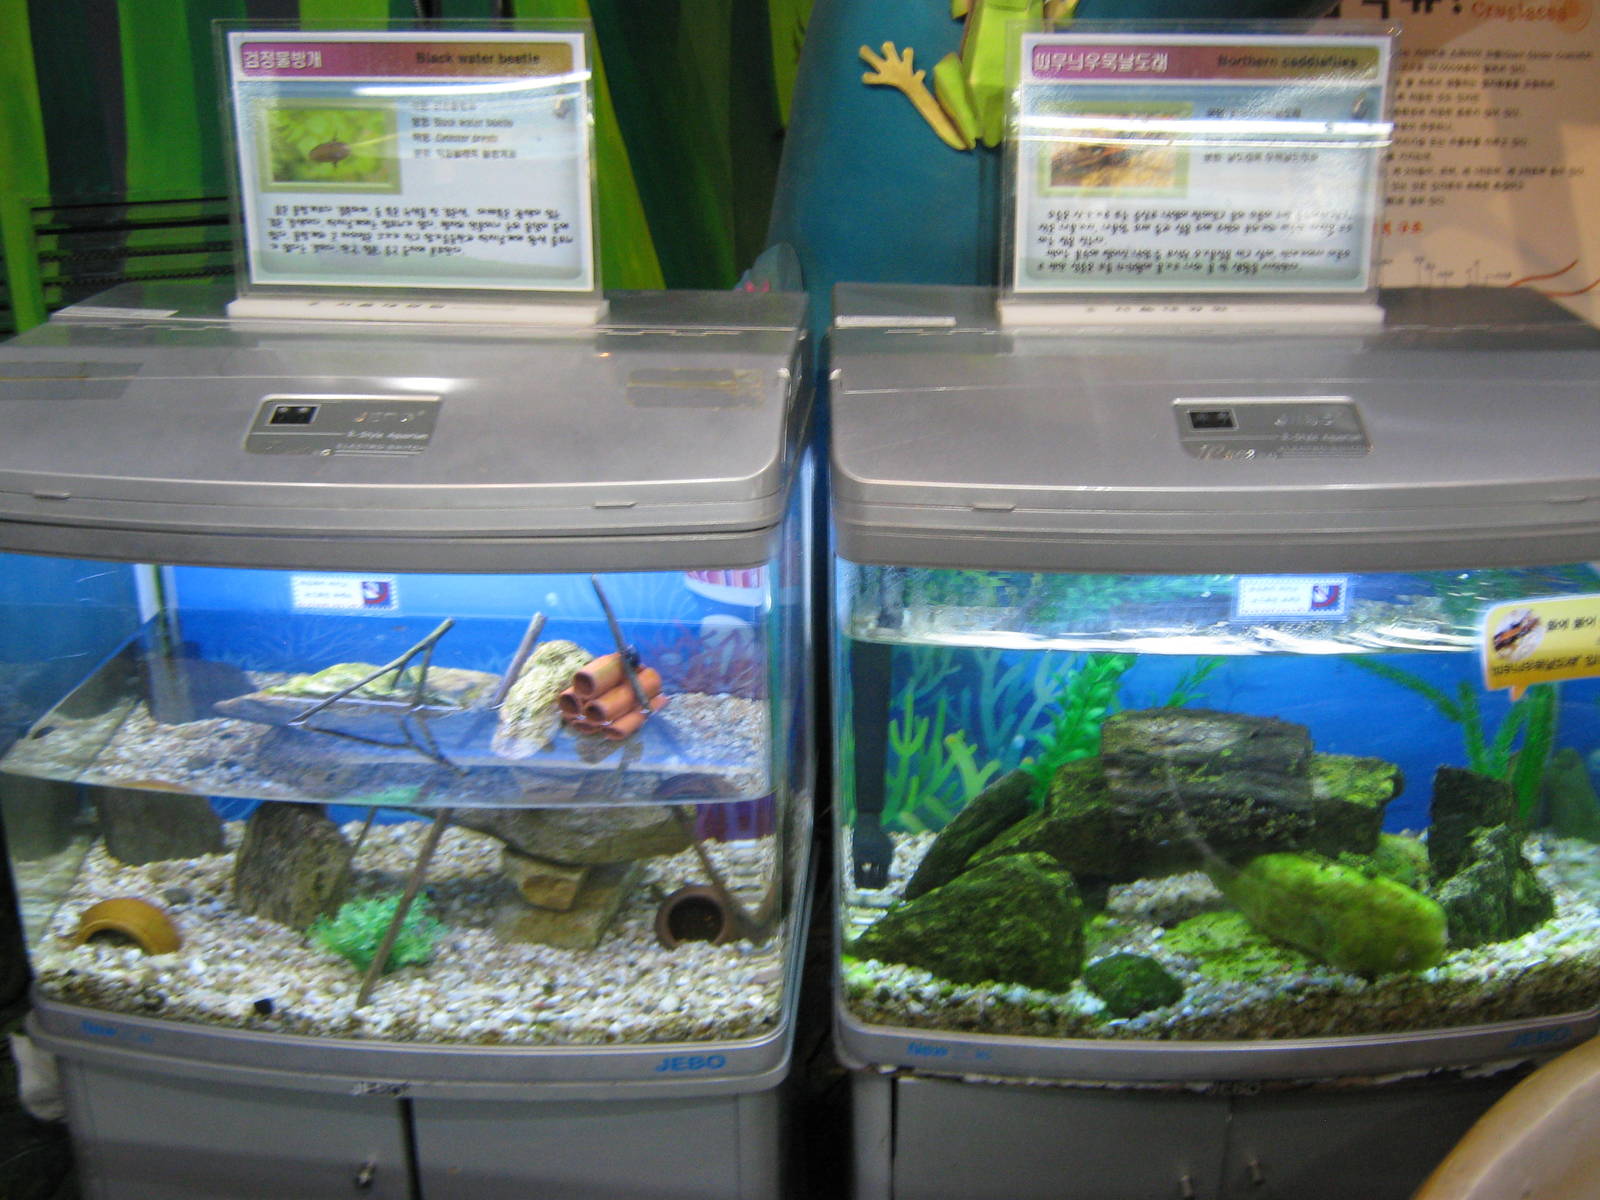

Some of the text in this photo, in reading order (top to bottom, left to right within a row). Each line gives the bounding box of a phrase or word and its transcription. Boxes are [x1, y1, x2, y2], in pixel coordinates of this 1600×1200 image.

[243, 50, 322, 70] 검정물방개
[415, 51, 541, 65] Black water beetle
[1217, 54, 1278, 68] Northern
[655, 1053, 727, 1073] JEBO
